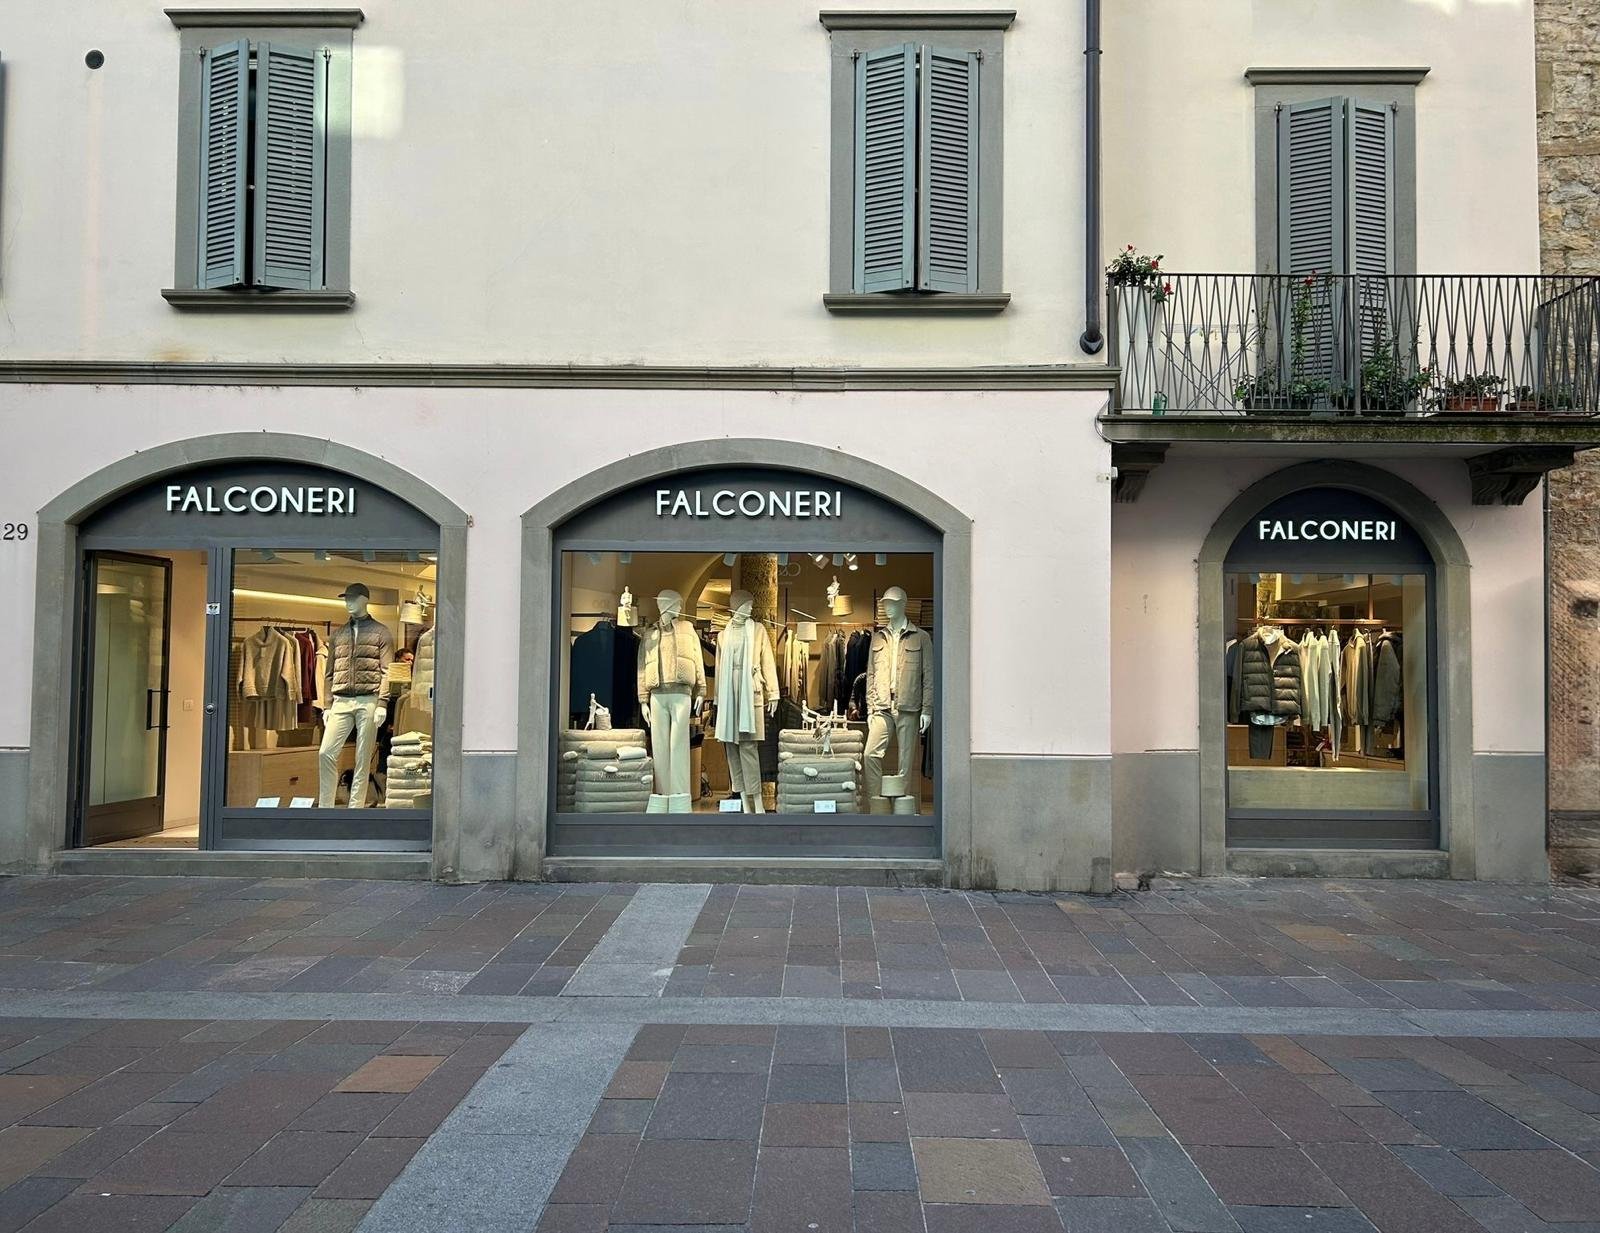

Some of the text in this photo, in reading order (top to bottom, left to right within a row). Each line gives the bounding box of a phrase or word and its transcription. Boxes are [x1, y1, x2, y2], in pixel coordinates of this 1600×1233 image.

[166, 485, 355, 513] FALCONERI
[656, 489, 841, 517] FALCONERI
[3, 523, 29, 541] 29
[1259, 520, 1396, 541] FALCONERI
